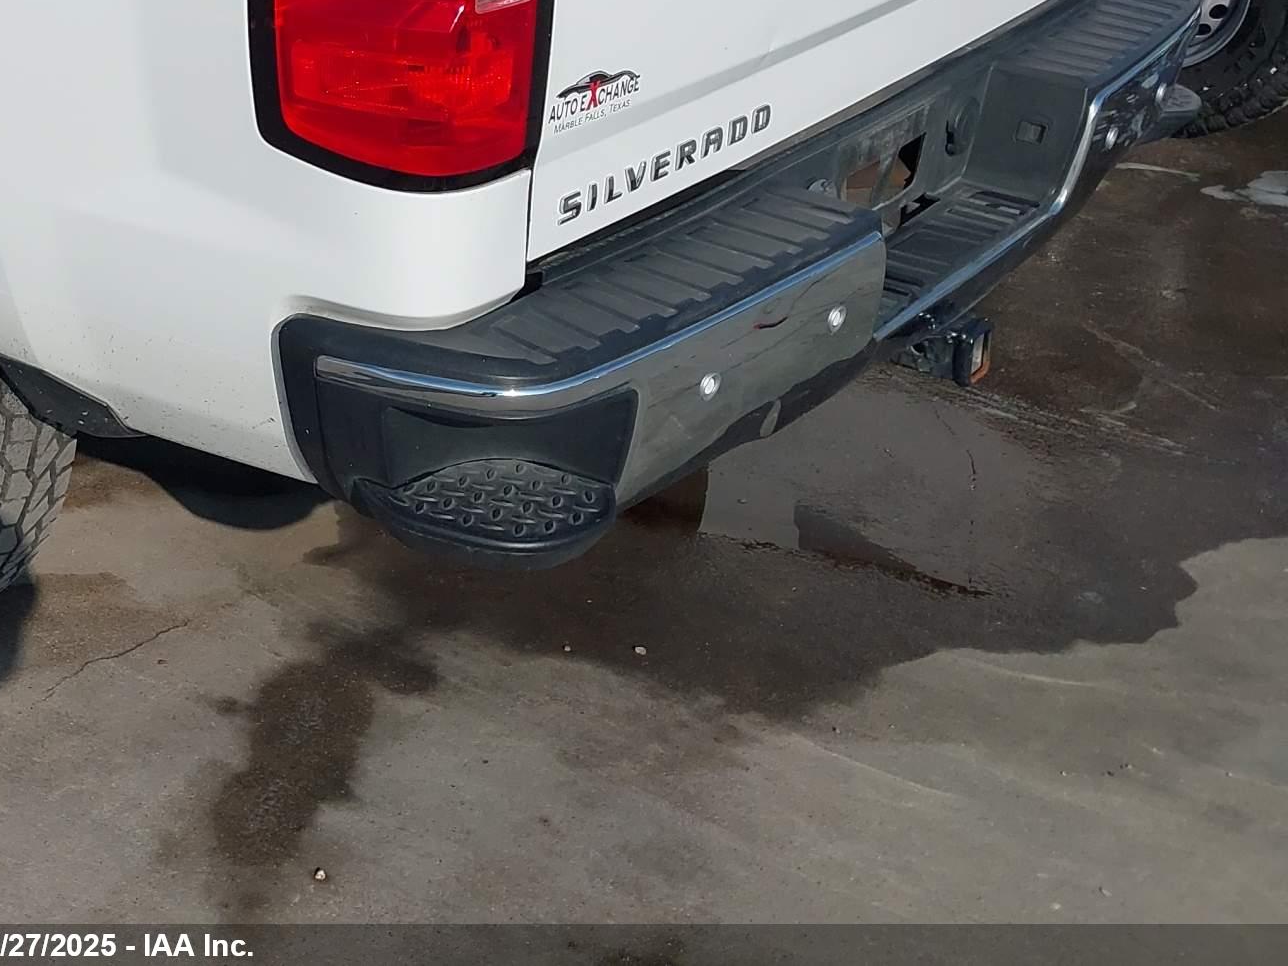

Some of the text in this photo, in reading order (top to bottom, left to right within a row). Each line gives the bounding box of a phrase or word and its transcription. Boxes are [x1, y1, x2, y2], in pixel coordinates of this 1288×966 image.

[549, 98, 578, 124] AUTO
[553, 99, 630, 134] MARBLE FALLS, TEXAS
[558, 104, 772, 225] SILVERADO
